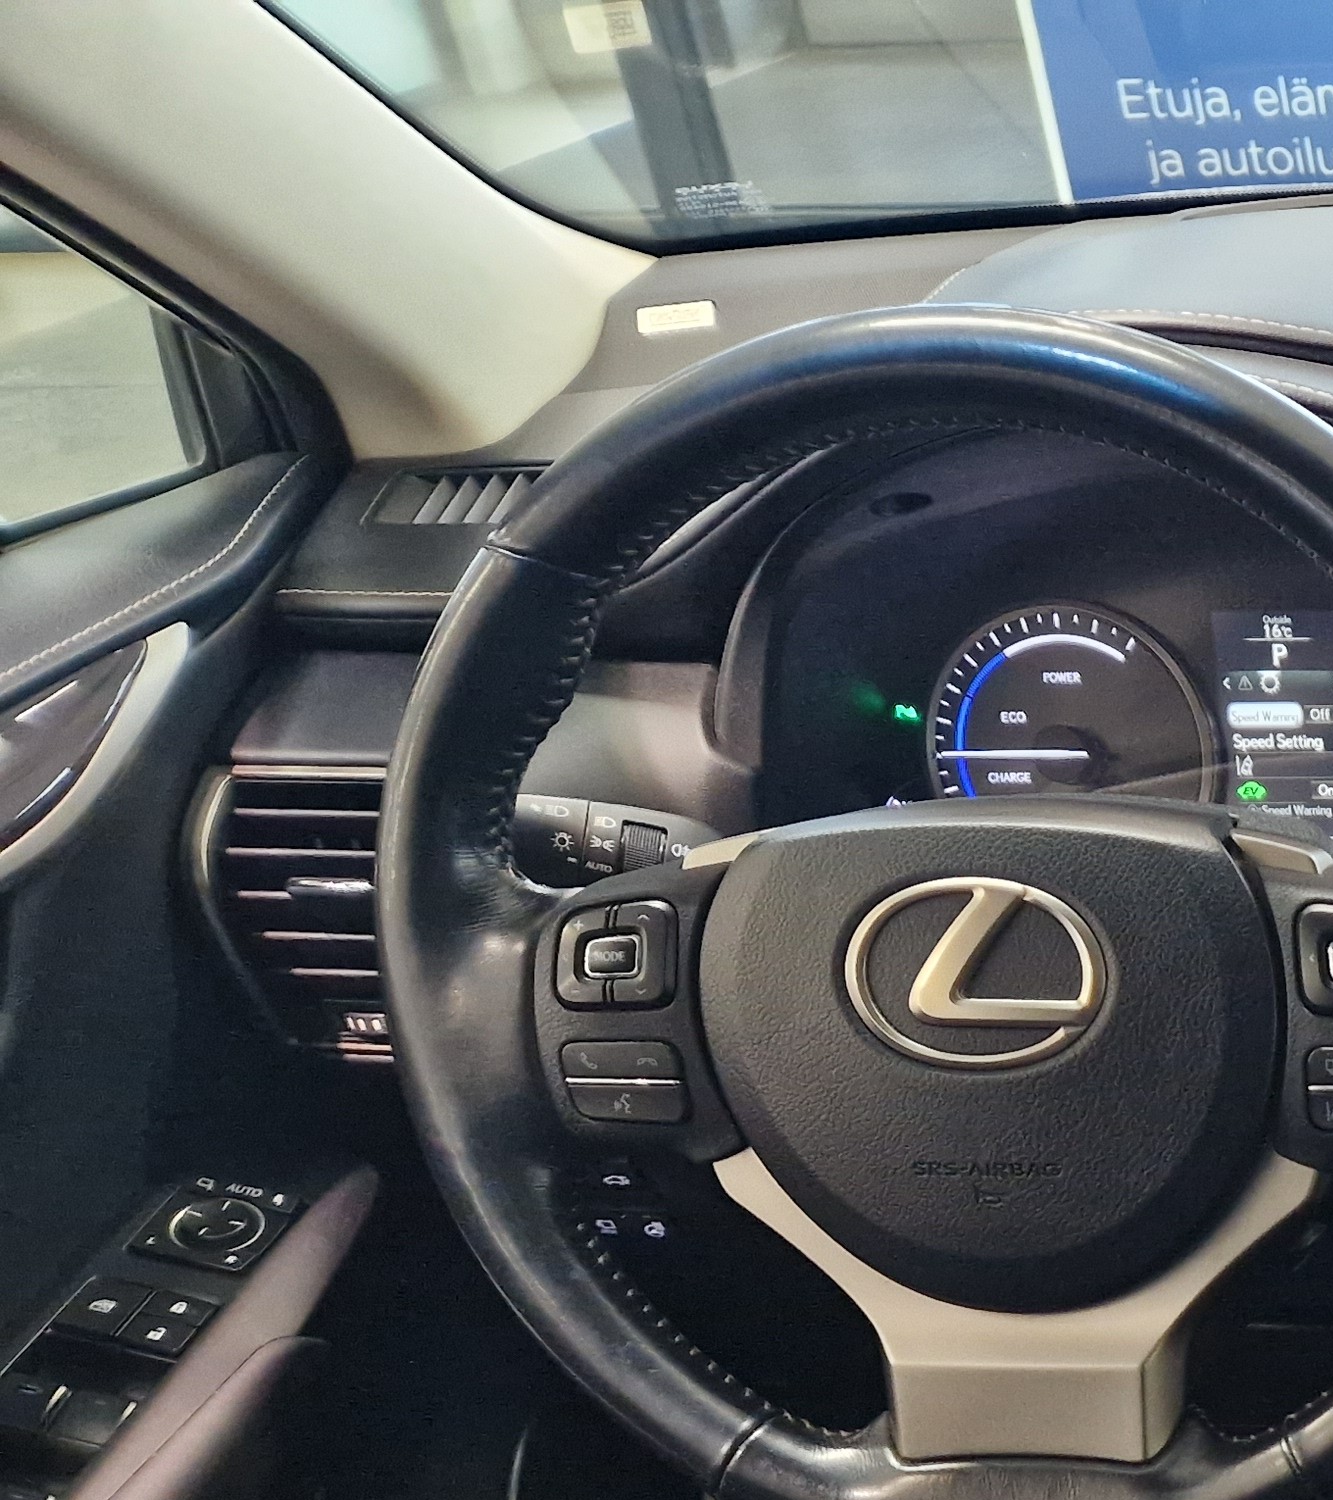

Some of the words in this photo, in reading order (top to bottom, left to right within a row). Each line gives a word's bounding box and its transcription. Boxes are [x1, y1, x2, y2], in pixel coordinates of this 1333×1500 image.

[1116, 76, 1242, 123] Etuja,
[1146, 139, 1184, 185] ja
[1271, 643, 1288, 668] P
[1042, 671, 1082, 685] POWER
[1000, 711, 1028, 724] ECO
[1231, 709, 1260, 722] Speed
[1261, 708, 1300, 722] Warning
[1310, 708, 1331, 721] Off
[1233, 733, 1276, 752] Speed
[1276, 733, 1324, 752] Setting
[987, 771, 1032, 784] CHARGE
[1243, 786, 1259, 796] EV
[1293, 804, 1333, 818] Warning
[584, 860, 613, 874] AUTO
[592, 951, 627, 962] MODE
[225, 1182, 264, 1198] AUTO
